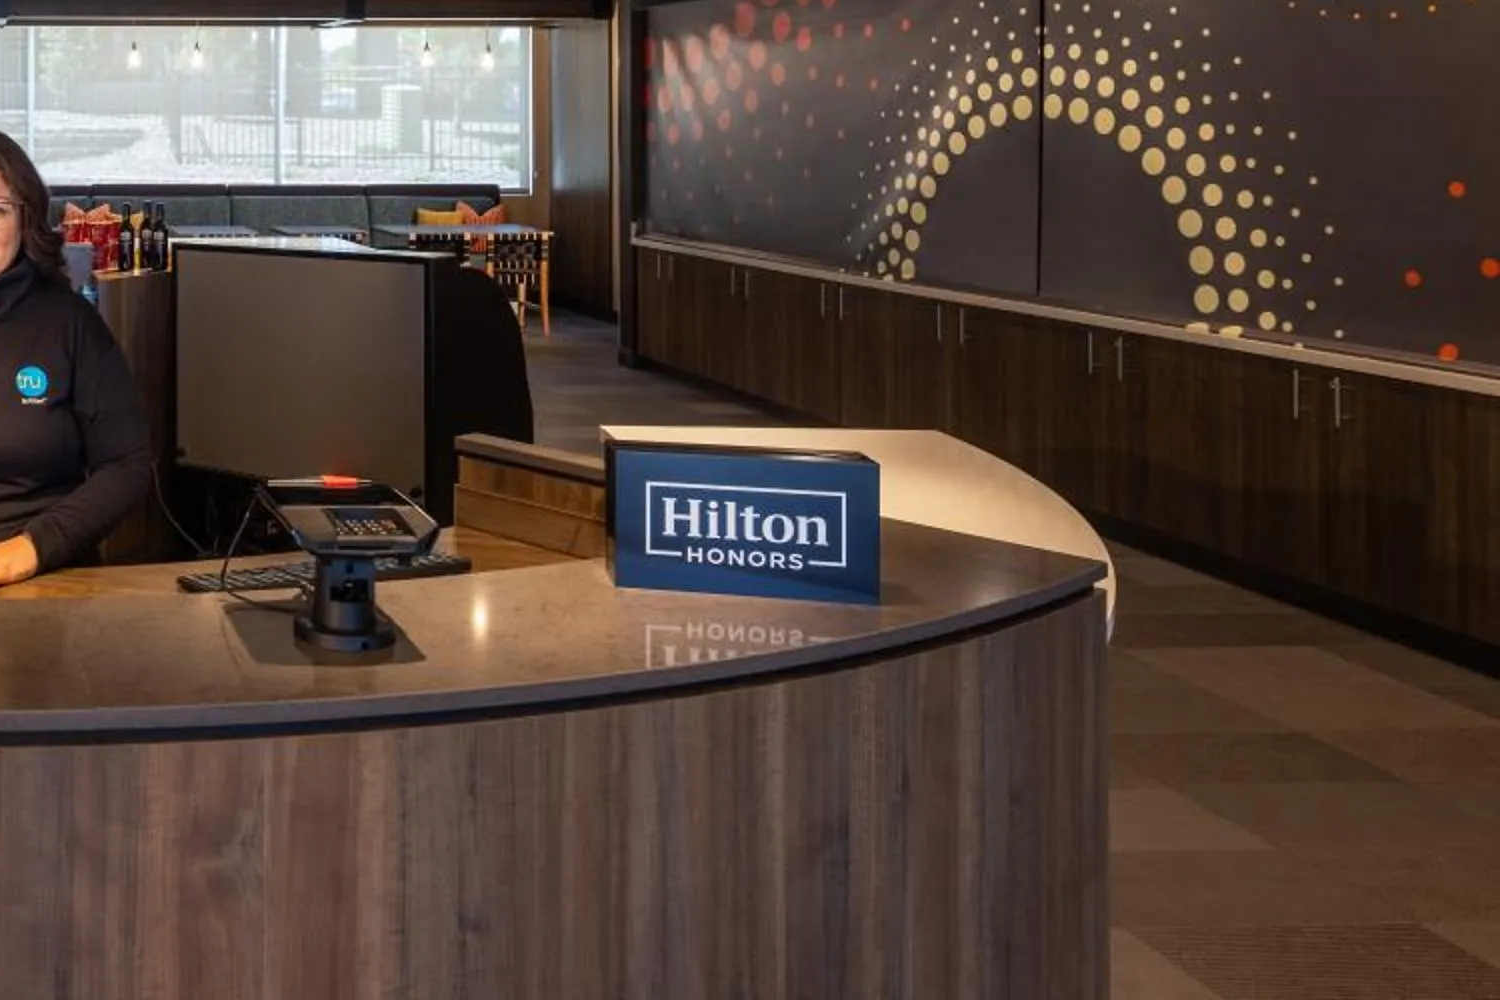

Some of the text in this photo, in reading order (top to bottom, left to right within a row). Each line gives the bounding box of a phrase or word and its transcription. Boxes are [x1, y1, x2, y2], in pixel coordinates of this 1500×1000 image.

[16, 372, 41, 389] tru
[661, 497, 829, 547] Hilton
[686, 546, 804, 571] HONORS
